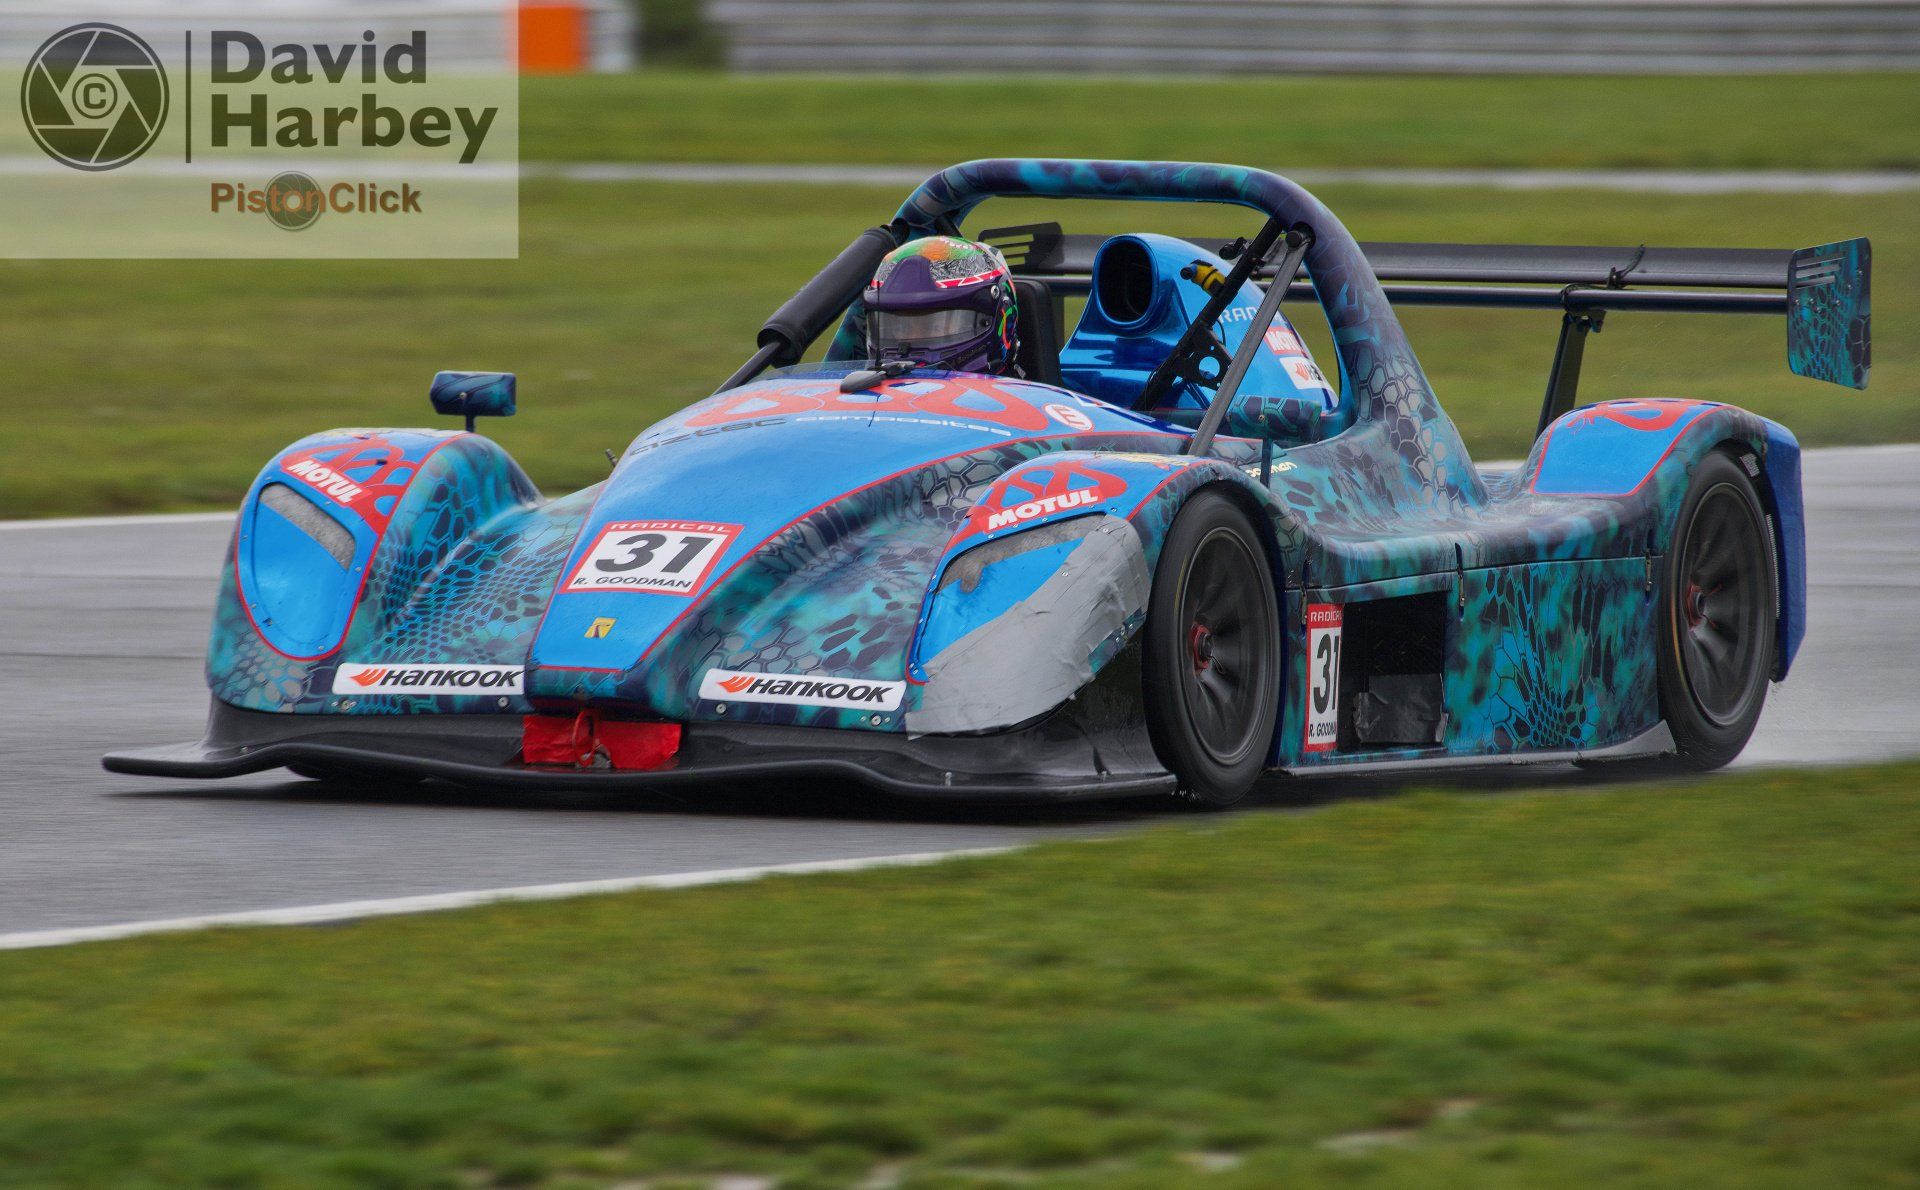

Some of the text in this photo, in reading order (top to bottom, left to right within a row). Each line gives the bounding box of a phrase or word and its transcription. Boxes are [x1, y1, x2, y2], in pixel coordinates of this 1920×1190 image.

[287, 459, 363, 503] MOTUL
[610, 522, 733, 533] RADICAL
[988, 490, 1098, 530] MOTUL
[595, 533, 715, 573] 31
[574, 576, 692, 588] R. GOODMAN
[1313, 633, 1340, 715] 31
